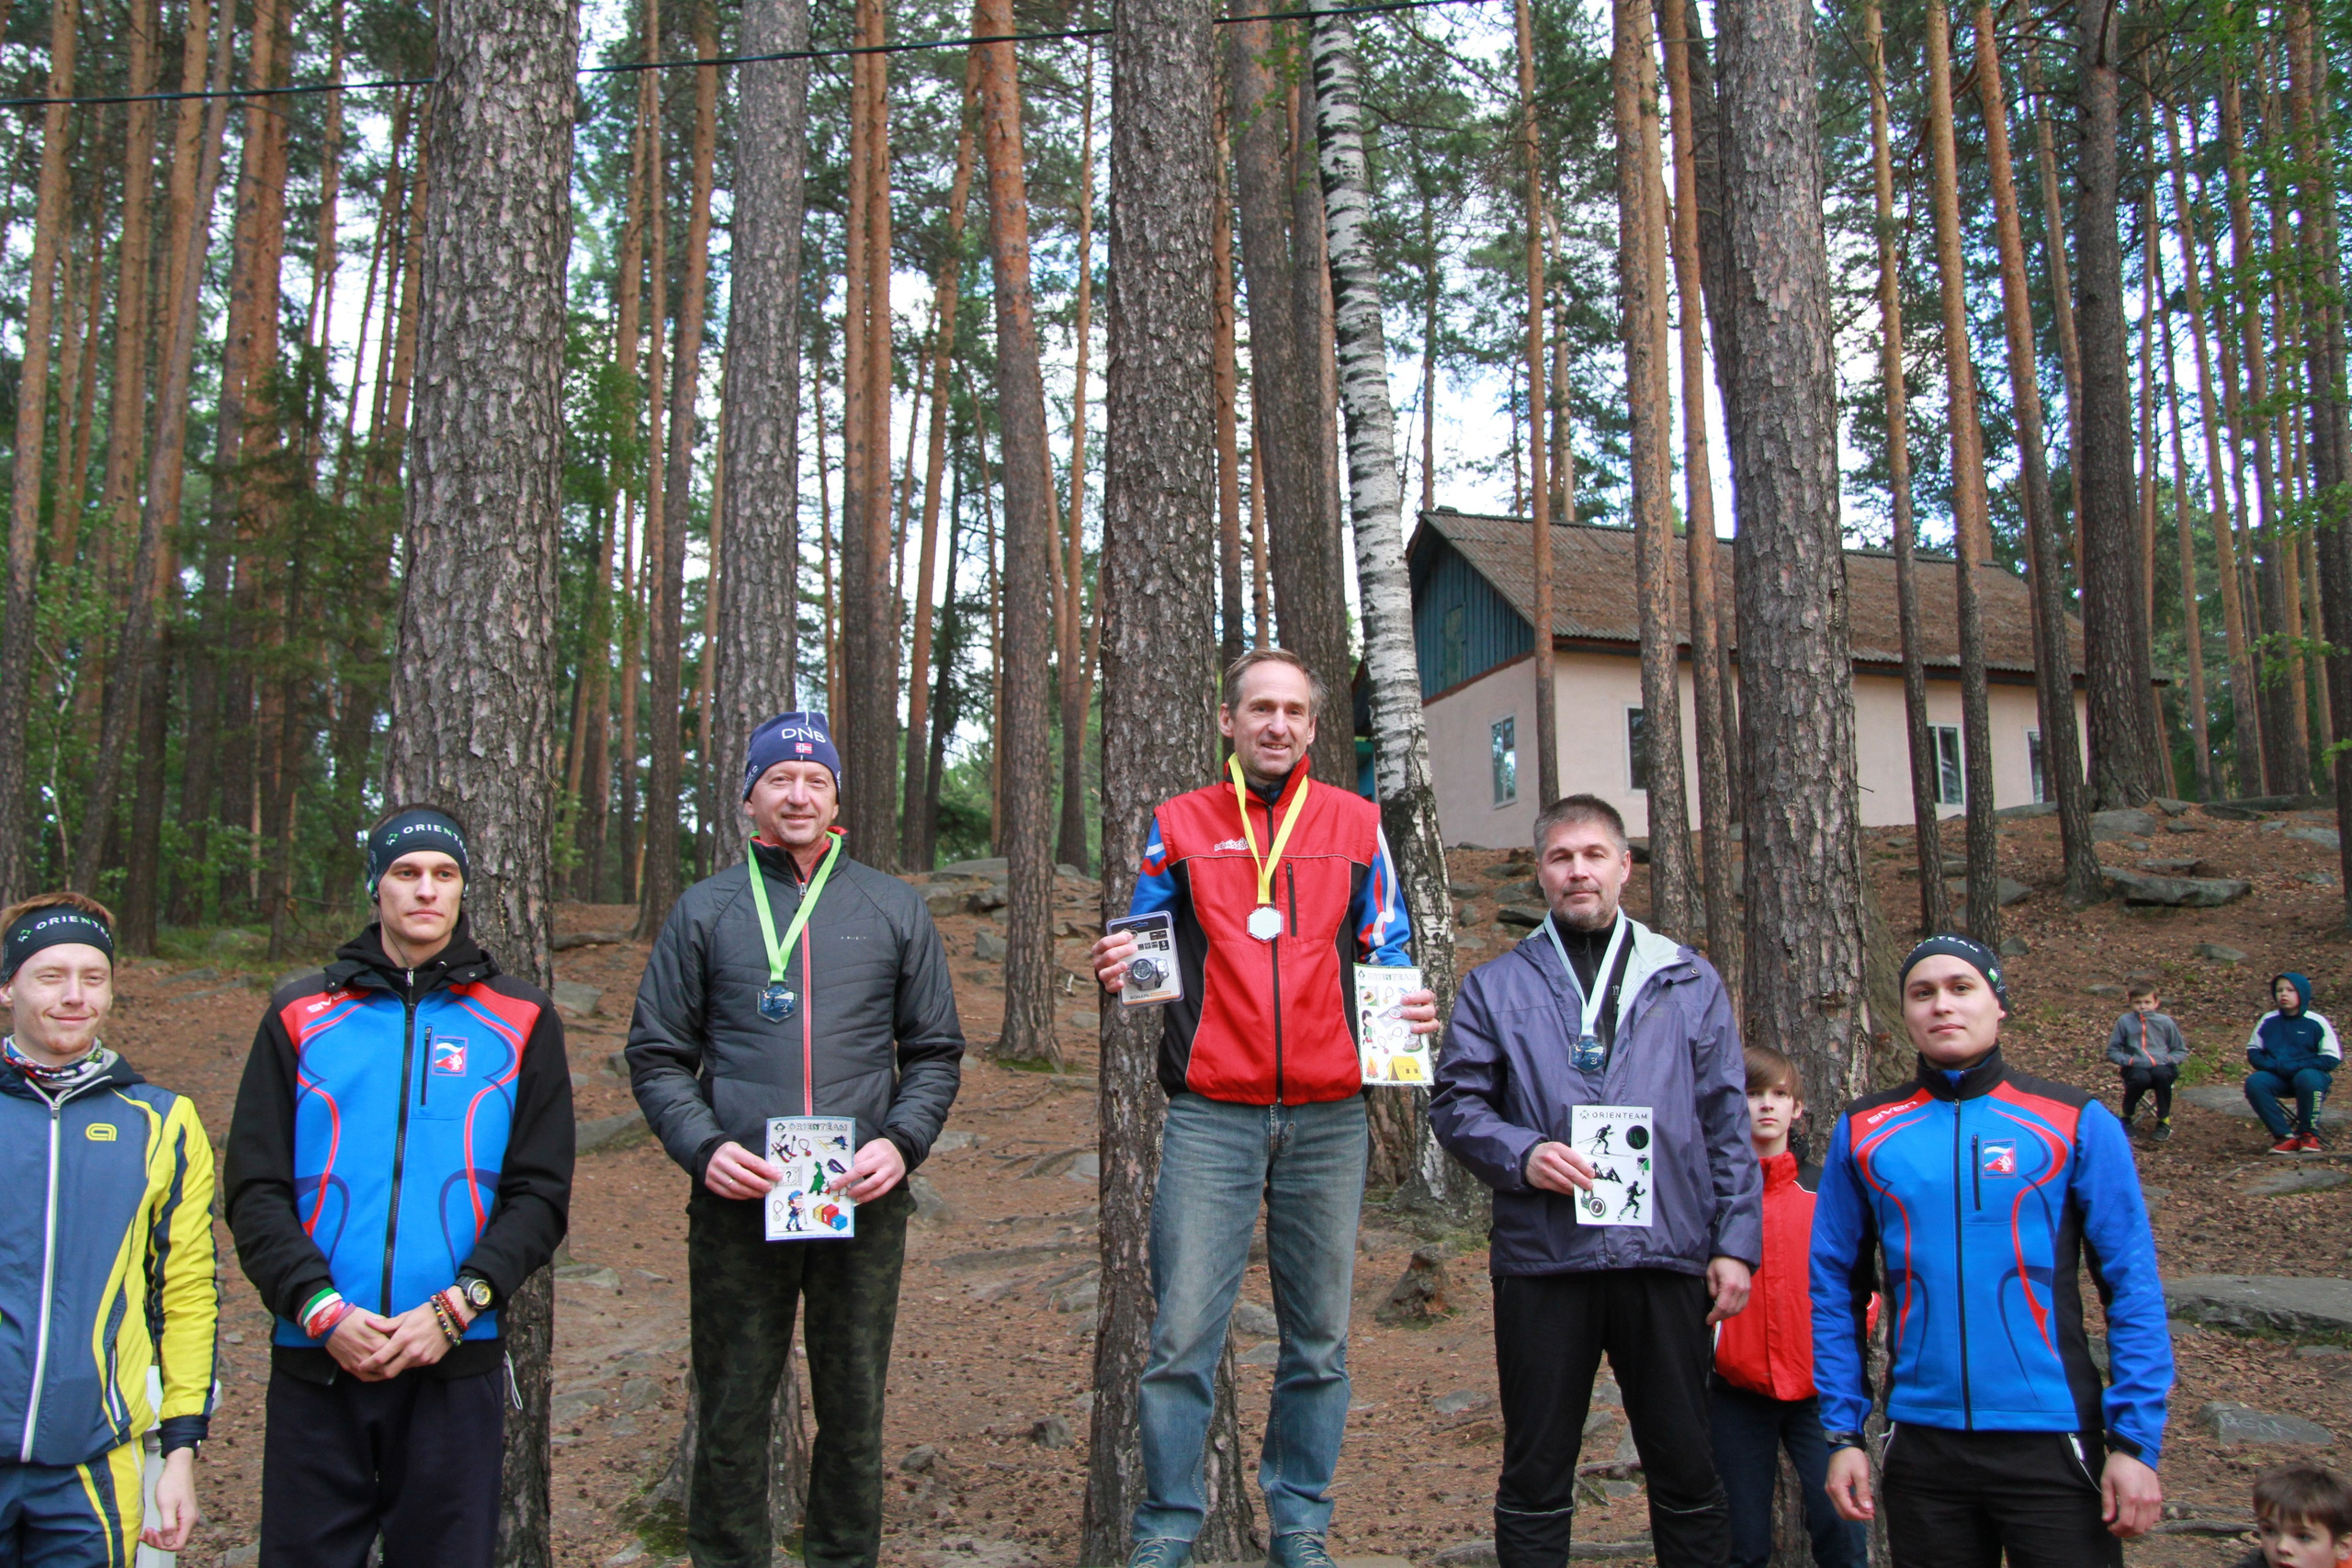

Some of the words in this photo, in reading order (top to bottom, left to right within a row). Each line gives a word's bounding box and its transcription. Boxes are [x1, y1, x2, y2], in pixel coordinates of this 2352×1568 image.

[781, 726, 826, 743] DNB
[402, 823, 469, 866] ORIENTE
[35, 915, 113, 947] ORIENTE
[780, 1003, 788, 1013] 2
[1589, 1056, 1598, 1066] 3
[1591, 1111, 1647, 1120] ORIENTEAM
[788, 1122, 848, 1132] ORIENTEAM
